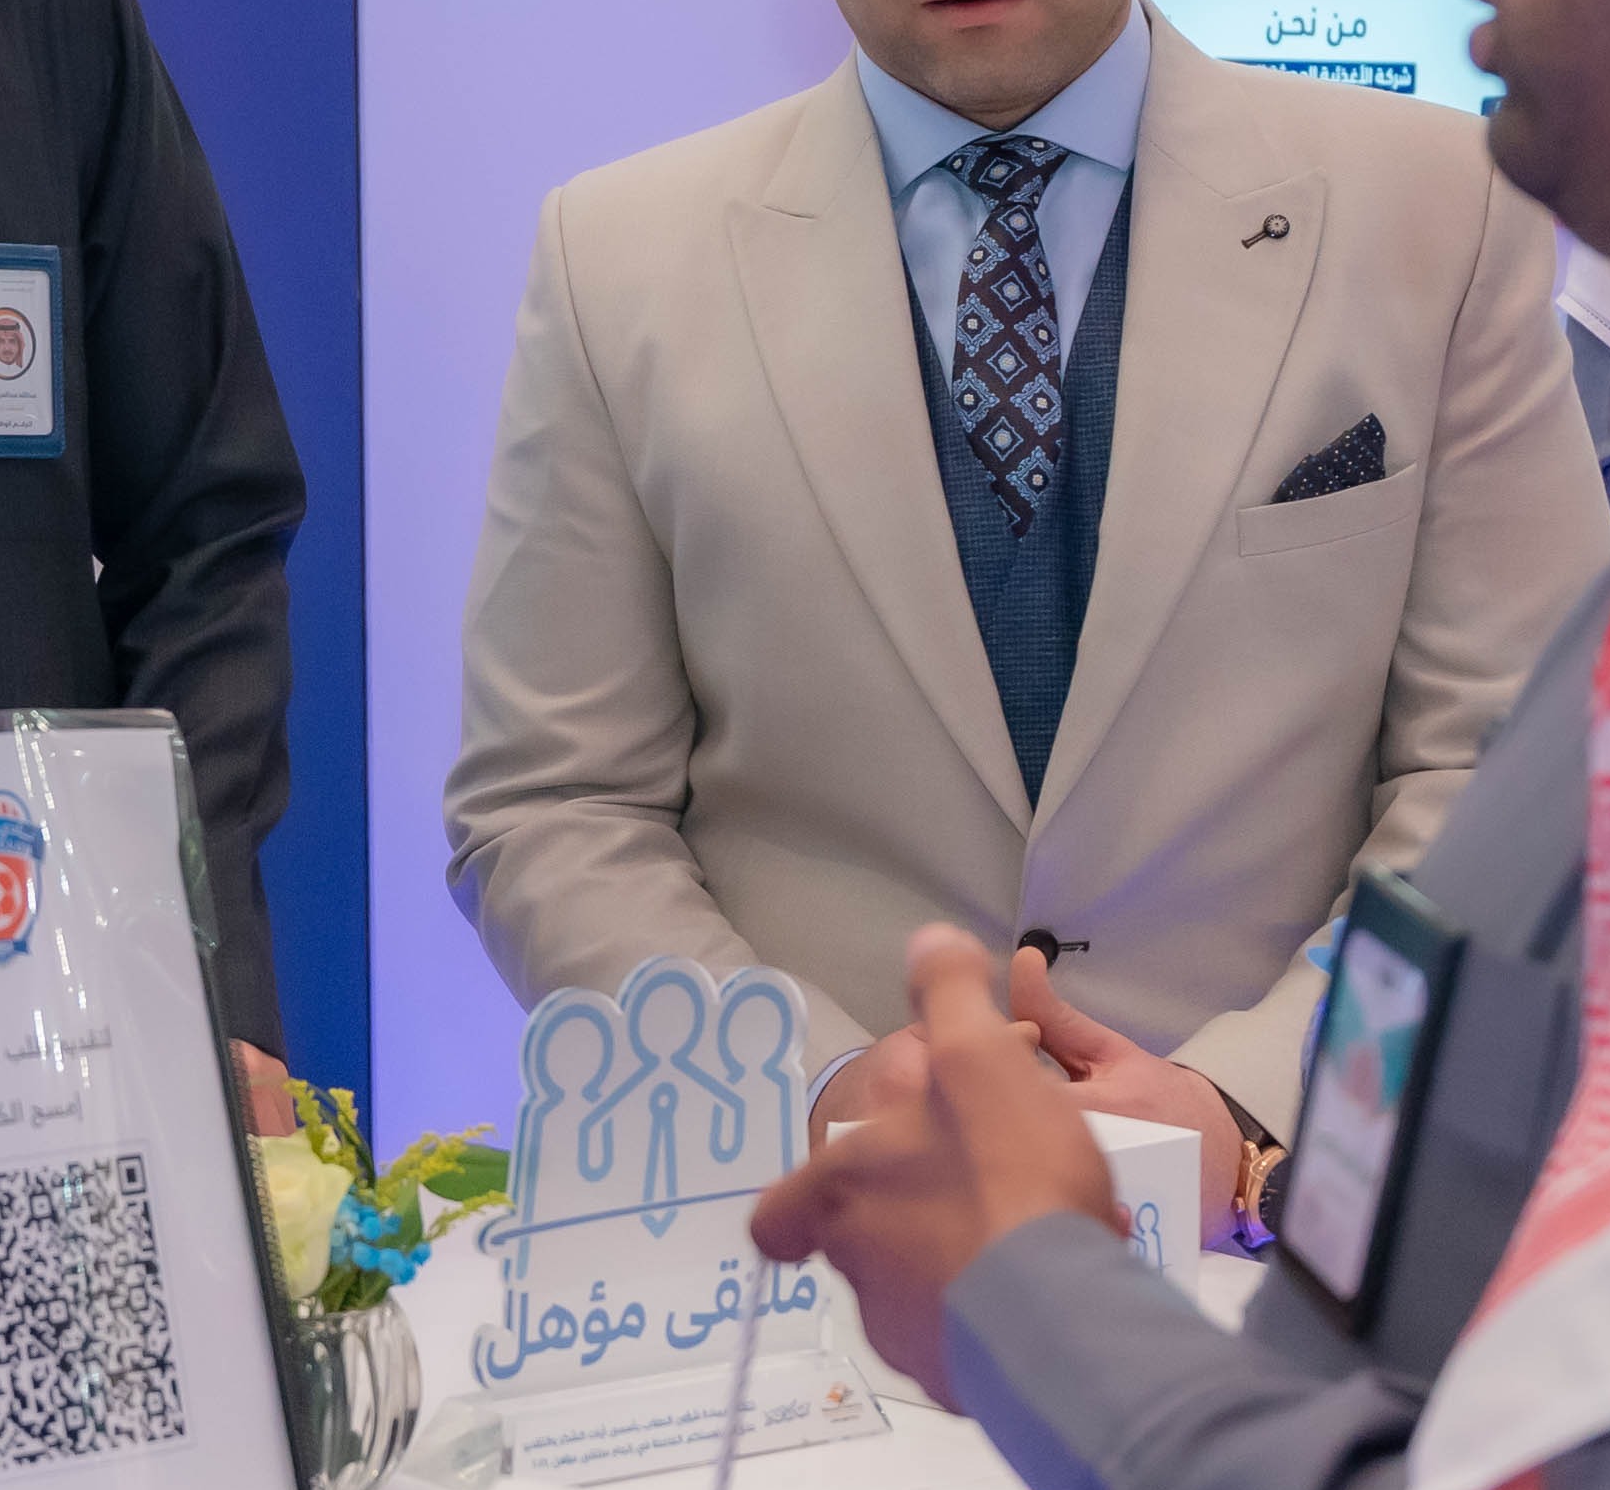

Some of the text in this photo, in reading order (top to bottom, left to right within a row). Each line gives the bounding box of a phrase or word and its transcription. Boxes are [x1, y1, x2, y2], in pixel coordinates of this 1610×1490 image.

[1265, 6, 1368, 47] من نحن
[1374, 63, 1413, 90] شركة
[485, 1279, 647, 1382] مؤهل
